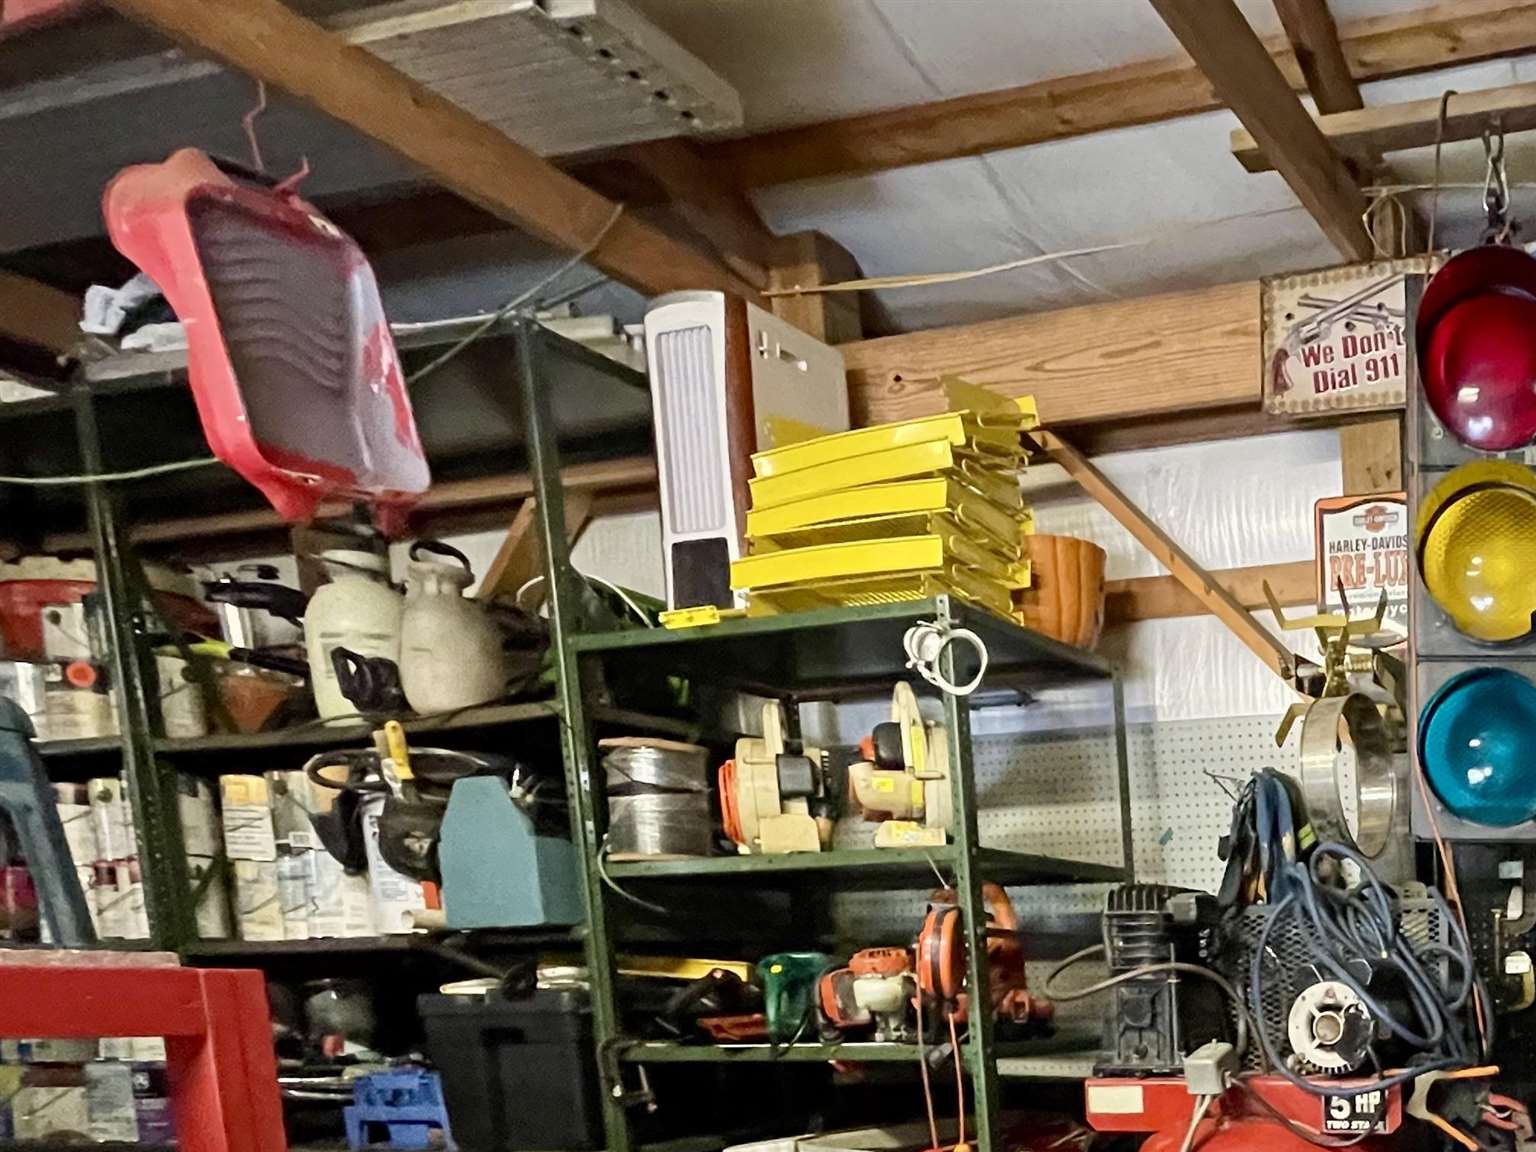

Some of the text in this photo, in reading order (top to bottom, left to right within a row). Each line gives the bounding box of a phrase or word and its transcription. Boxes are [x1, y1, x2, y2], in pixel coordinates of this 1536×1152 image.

[1301, 324, 1404, 368] We Don't
[1313, 353, 1400, 394] Dial 911
[1328, 534, 1408, 554] HARLEY-DAVIDS
[1329, 549, 1408, 592] PRE-LUX
[1330, 1090, 1381, 1120] 5 HP
[1326, 1120, 1350, 1130] TWO
